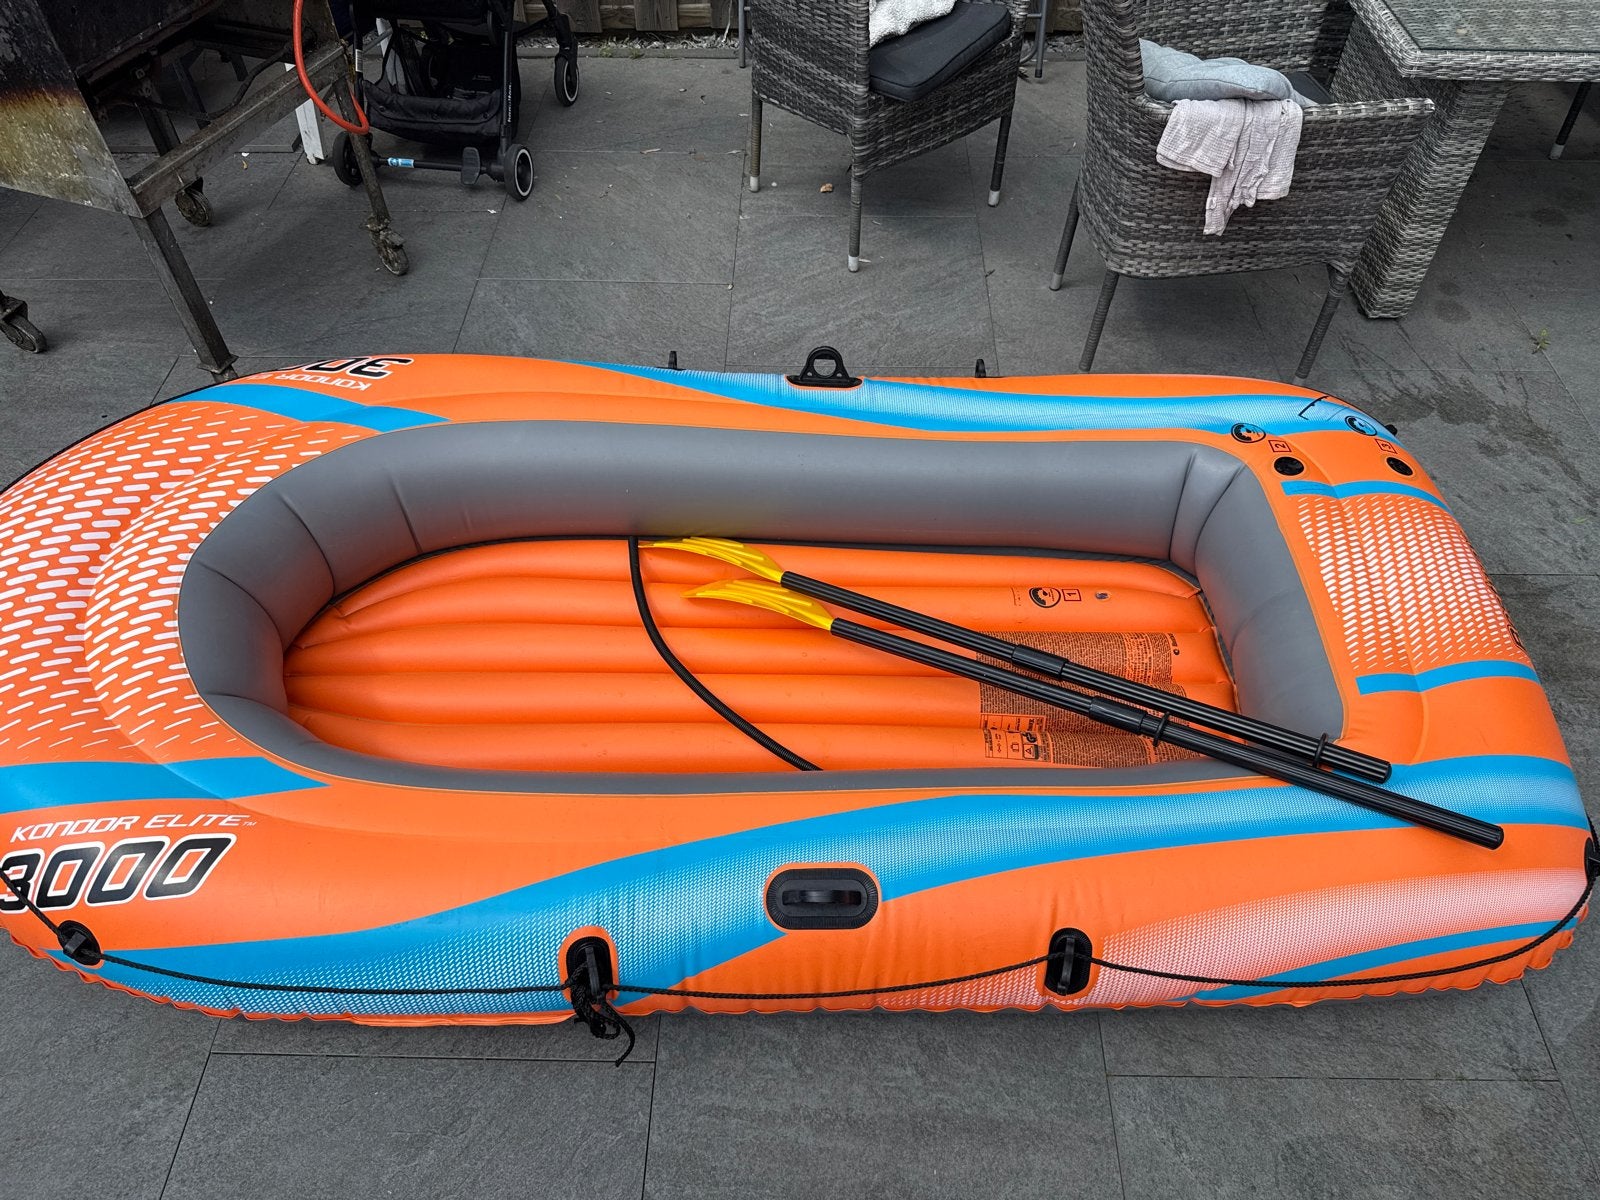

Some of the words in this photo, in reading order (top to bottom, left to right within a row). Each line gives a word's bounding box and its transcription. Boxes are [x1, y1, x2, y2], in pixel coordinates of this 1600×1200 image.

[275, 373, 372, 391] KONDOR
[10, 816, 140, 842] KONDOR
[0, 833, 237, 913] 3000
